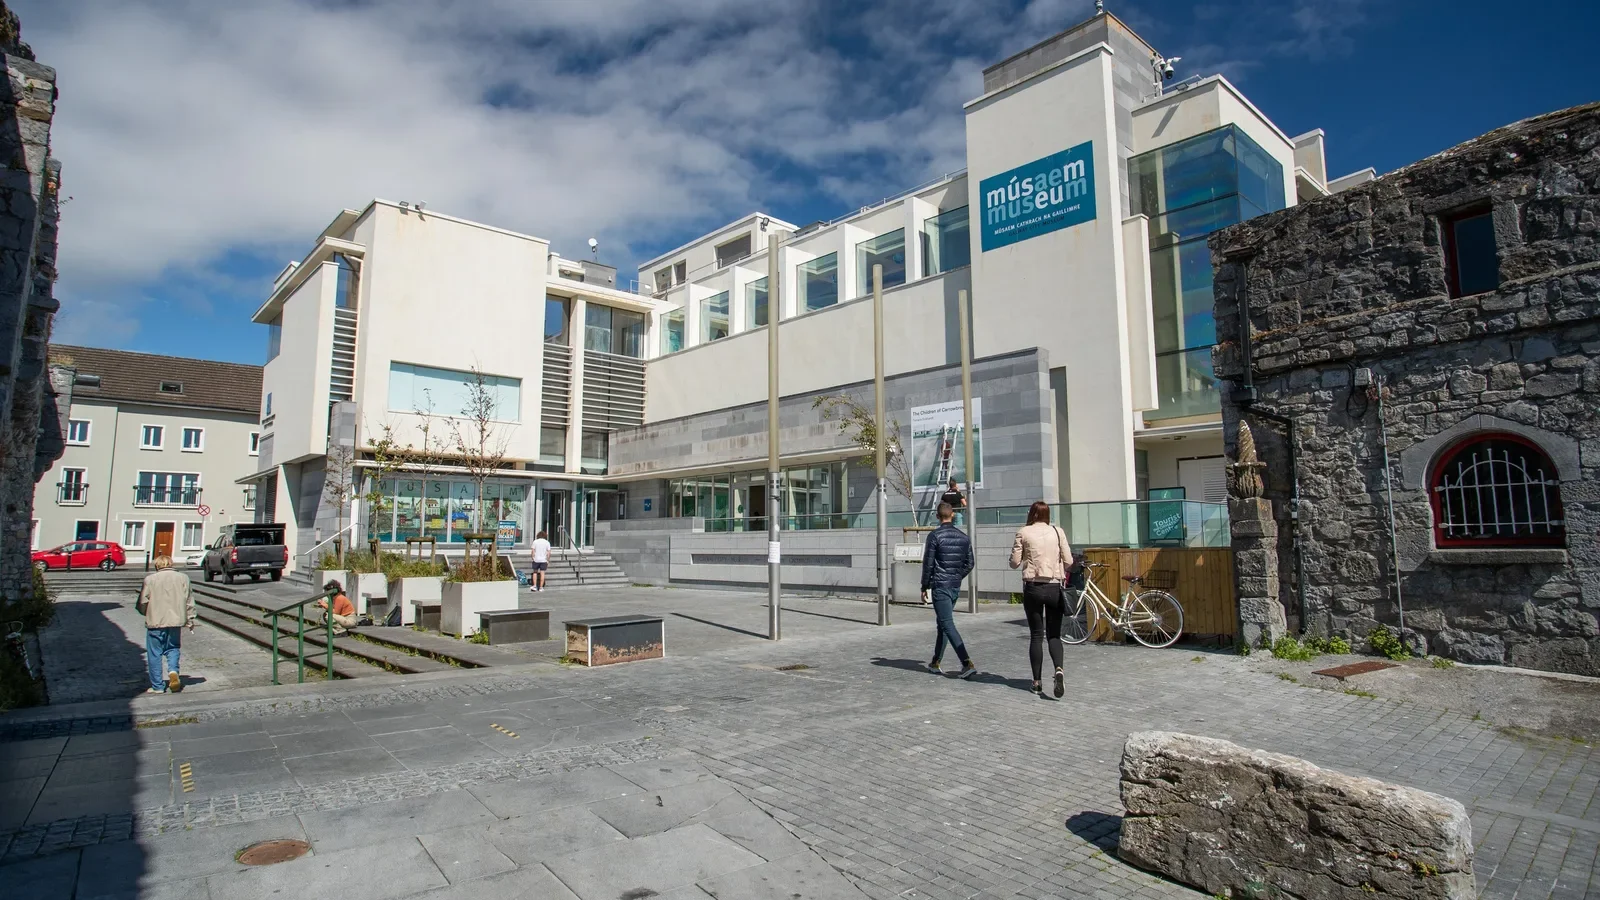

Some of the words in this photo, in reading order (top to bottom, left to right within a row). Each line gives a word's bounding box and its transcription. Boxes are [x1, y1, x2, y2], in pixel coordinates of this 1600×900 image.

[987, 159, 1085, 208] músaem
[988, 177, 1087, 225] museum
[1042, 215, 1065, 225] MUSEUM
[1153, 513, 1181, 528] Tourist
[498, 528, 515, 536] OPEN
